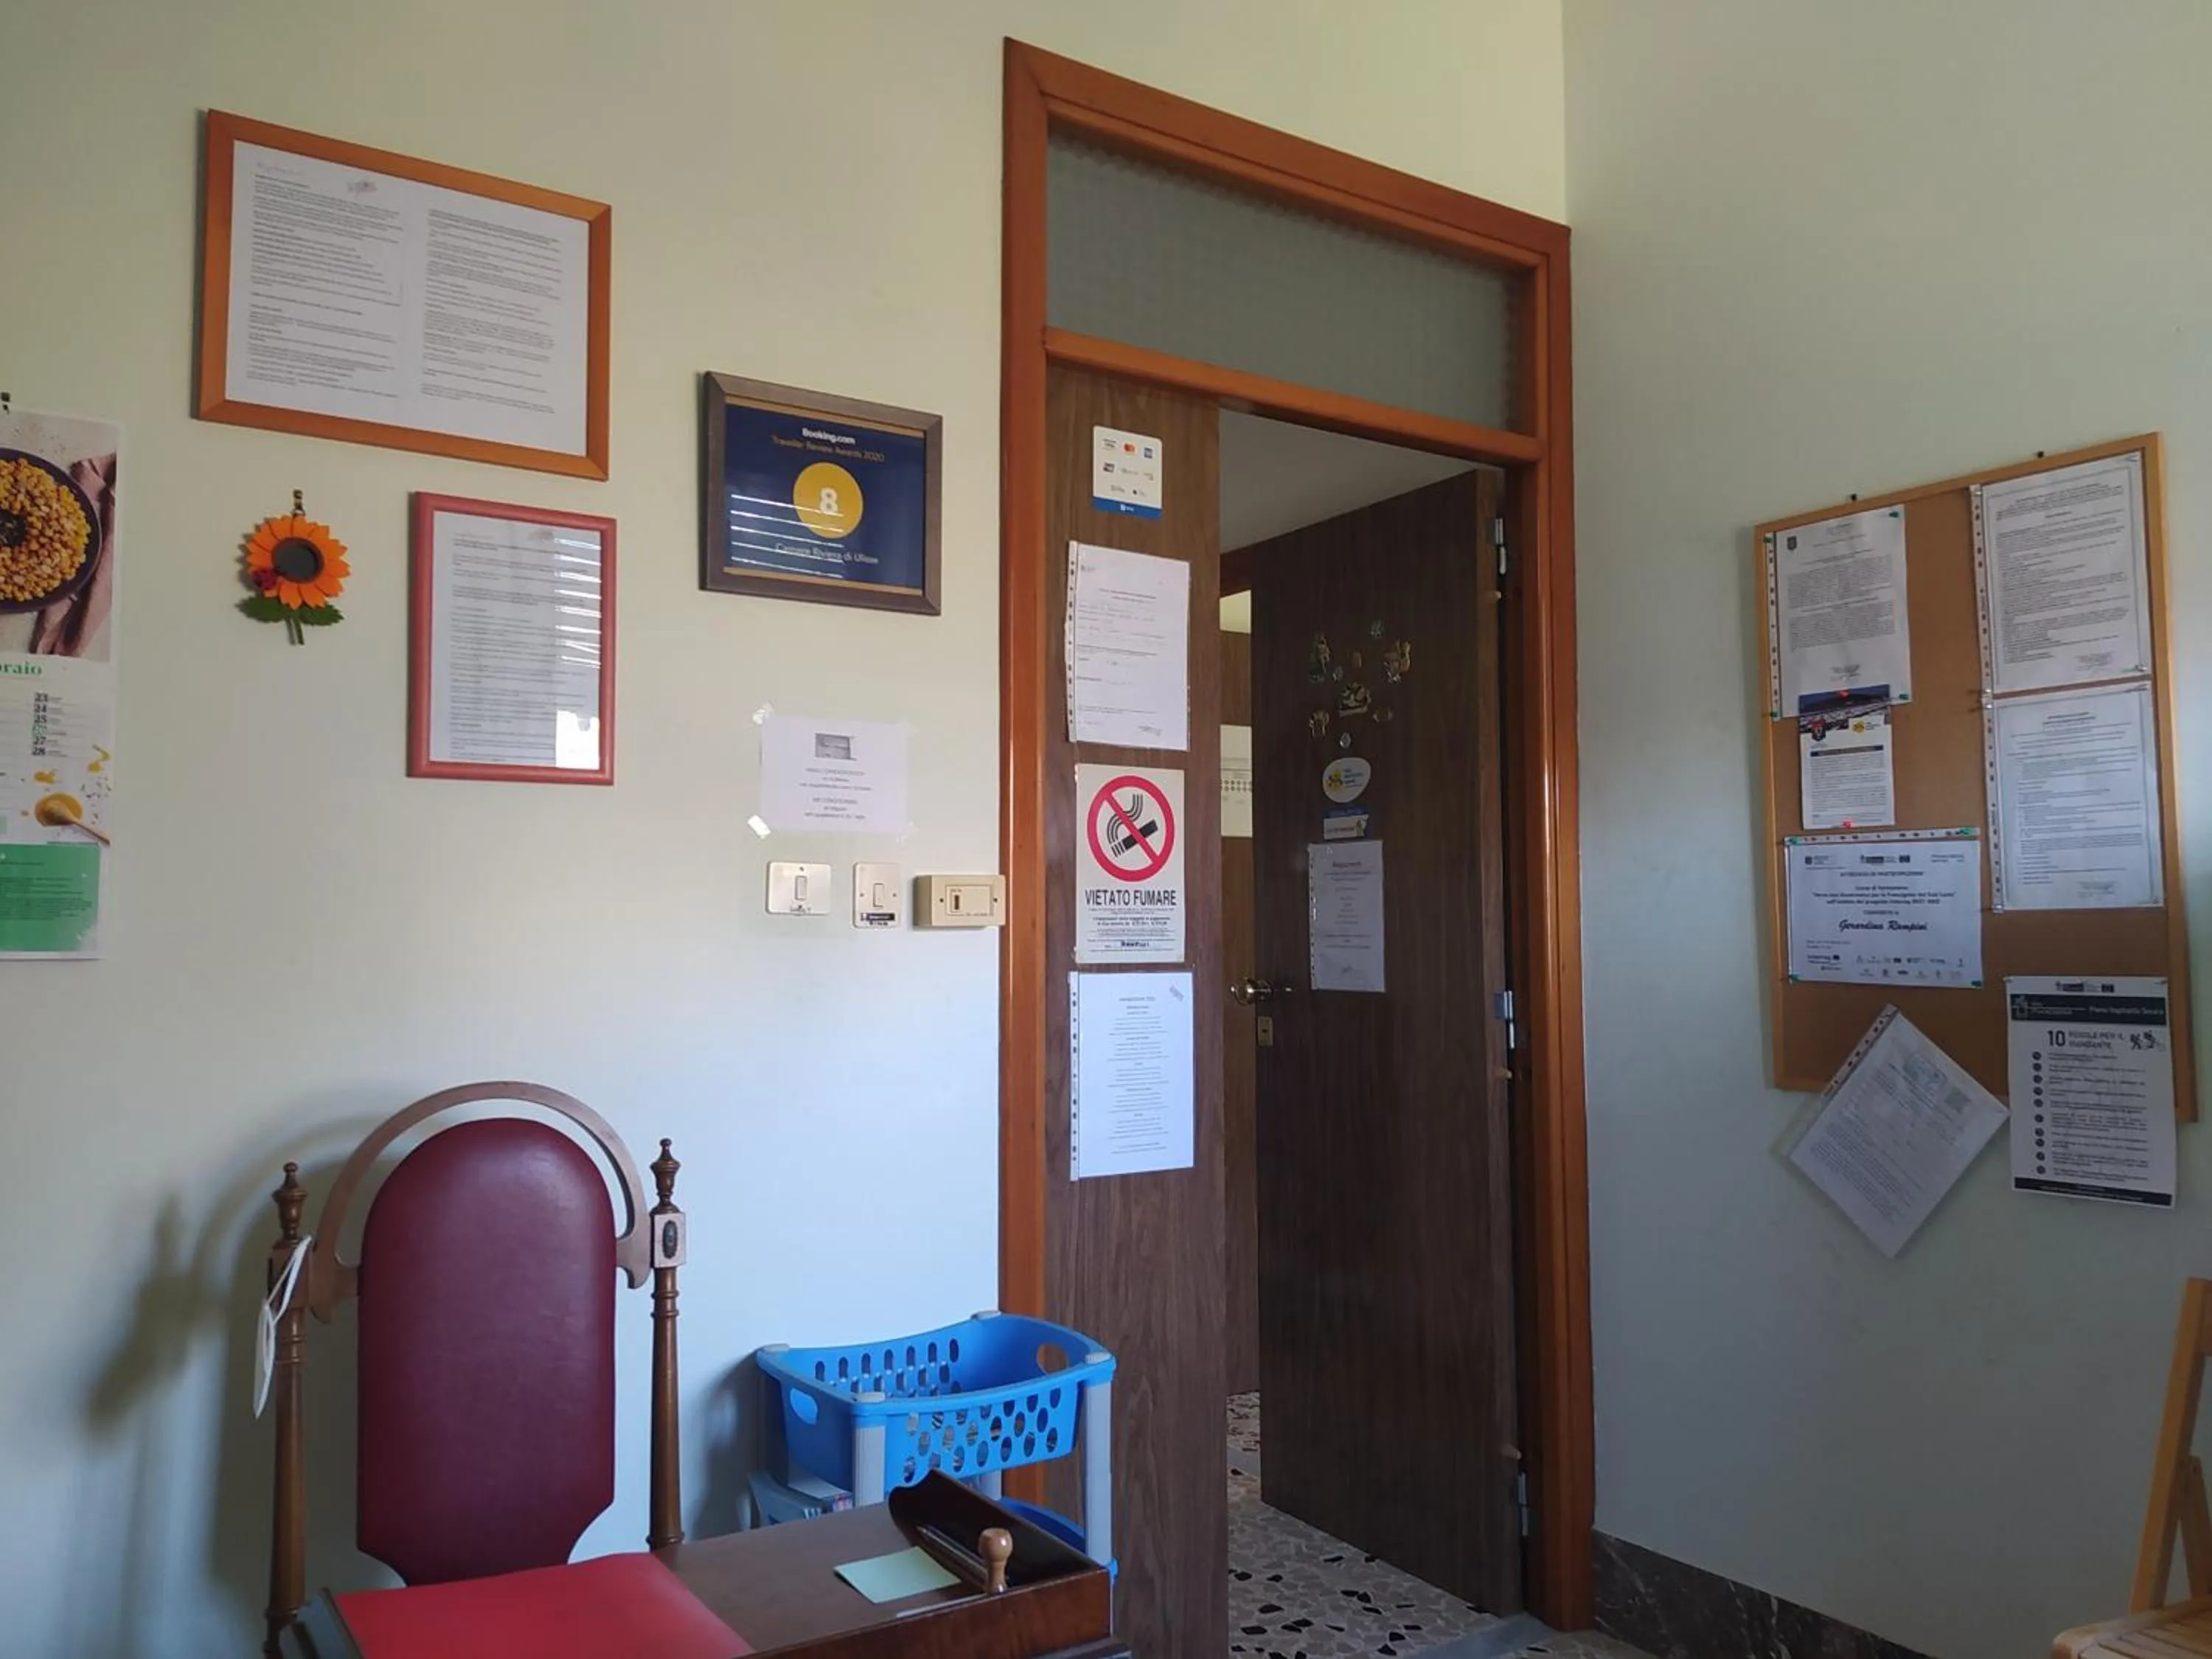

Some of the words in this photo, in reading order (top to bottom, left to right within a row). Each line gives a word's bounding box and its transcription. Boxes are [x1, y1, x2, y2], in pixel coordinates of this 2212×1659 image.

[801, 427, 856, 444] Booking.com
[863, 451, 885, 462] 2020
[820, 487, 838, 514] 8
[0, 661, 42, 675] raio
[1085, 889, 1130, 905] VIETATO
[1133, 889, 1177, 905] FUMARE
[2048, 1030, 2066, 1047] 10
